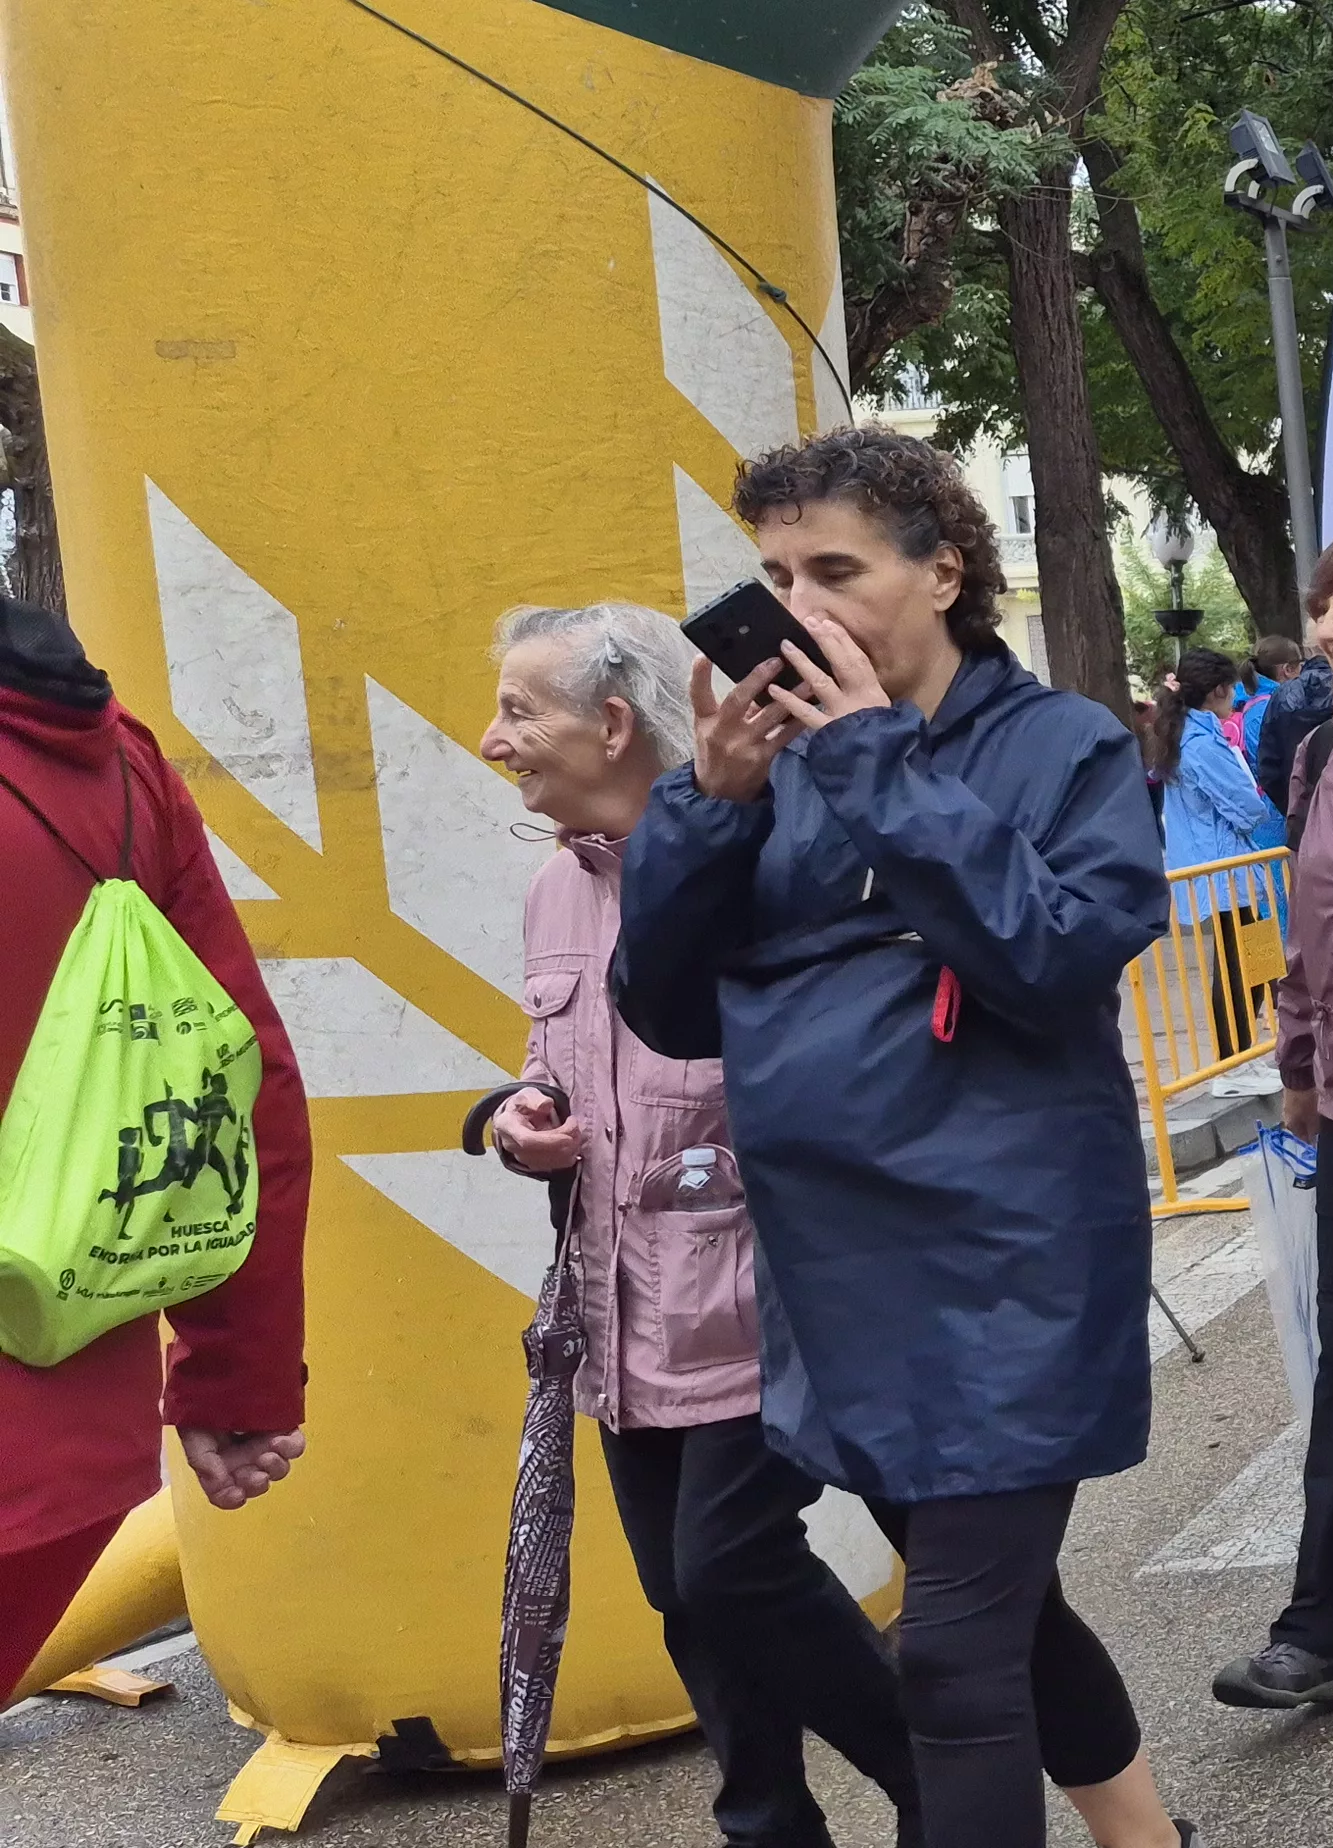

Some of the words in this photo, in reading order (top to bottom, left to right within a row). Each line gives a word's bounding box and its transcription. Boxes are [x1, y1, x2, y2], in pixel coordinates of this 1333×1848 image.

[171, 1220, 230, 1238] HUESCA
[148, 1244, 179, 1259] POR
[184, 1240, 202, 1254] LA
